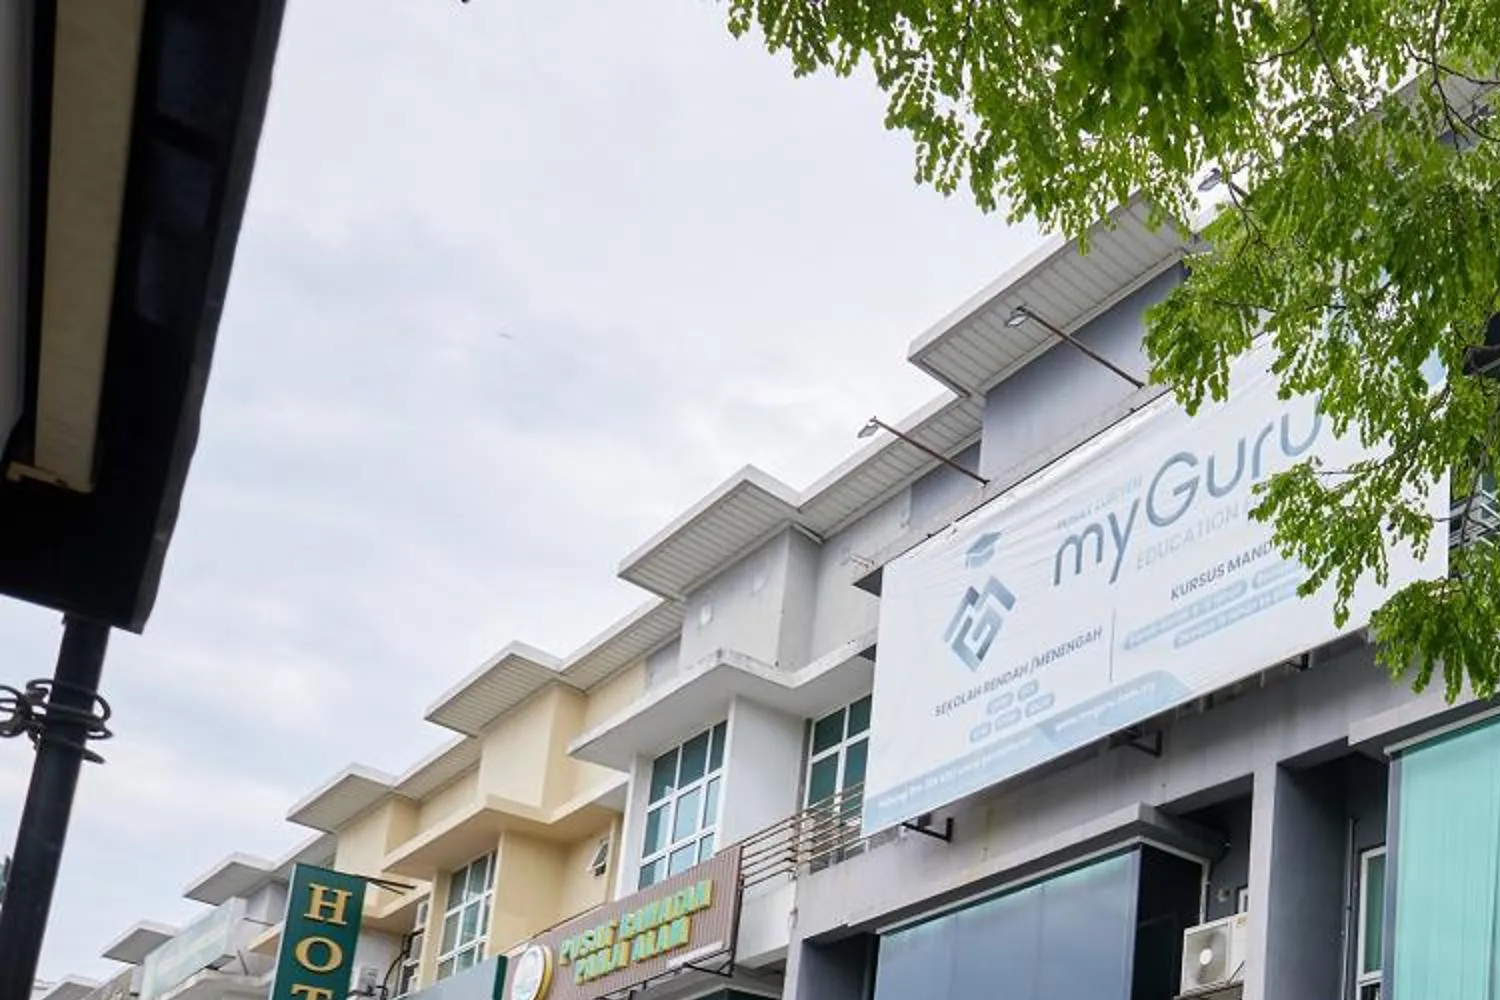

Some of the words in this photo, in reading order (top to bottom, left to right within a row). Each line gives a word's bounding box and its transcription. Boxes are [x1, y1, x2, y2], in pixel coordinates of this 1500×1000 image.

[1053, 396, 1324, 585] myGuru
[1169, 563, 1226, 602] KURSUS
[934, 683, 982, 718] SEKOLAH
[981, 659, 1030, 696] RENDAH
